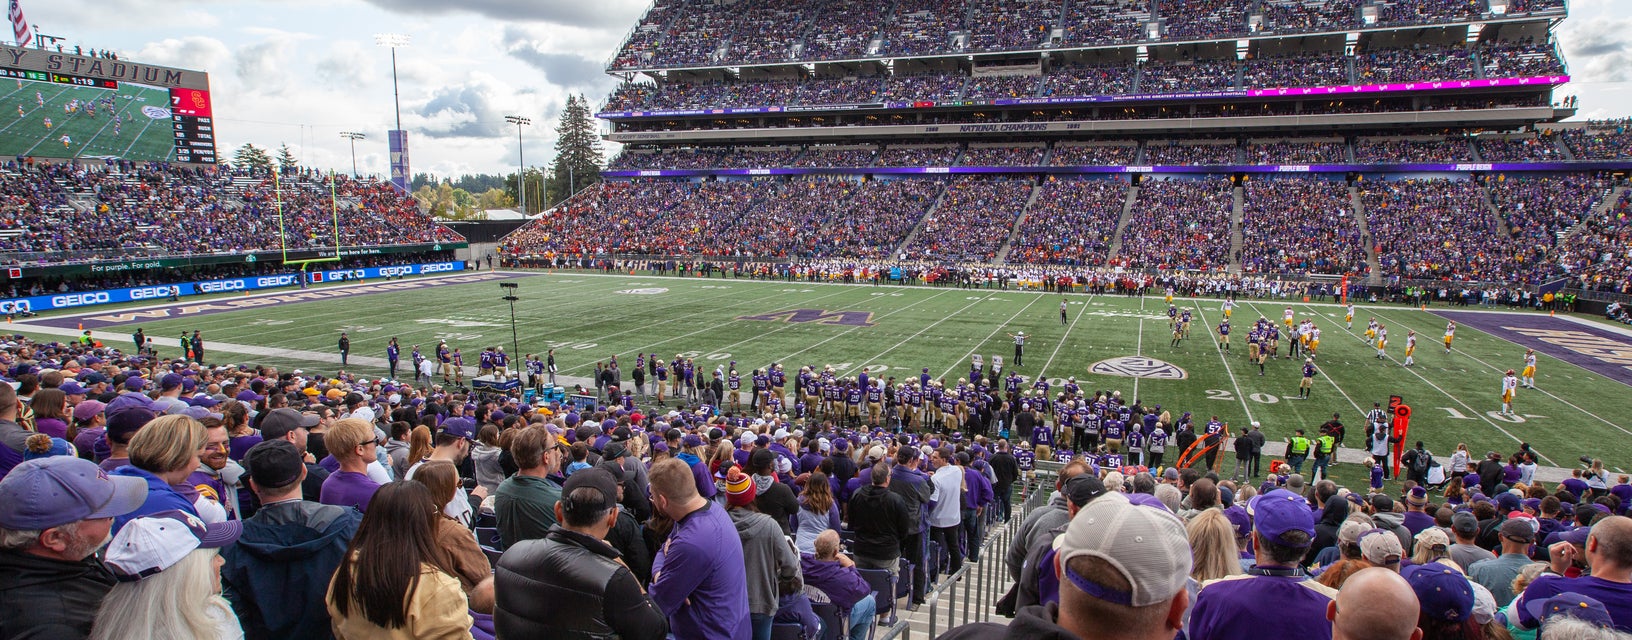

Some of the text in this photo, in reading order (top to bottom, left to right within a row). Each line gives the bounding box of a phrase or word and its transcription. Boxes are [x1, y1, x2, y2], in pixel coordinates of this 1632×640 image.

[48, 54, 184, 85] STADIUM
[71, 77, 94, 86] 1:19
[172, 96, 180, 105] 7
[959, 124, 998, 132] NATIONAL
[1000, 123, 1048, 132] CHAMPIONS
[91, 260, 162, 273] For purple. For gold.
[422, 262, 454, 273] GEICO
[202, 279, 245, 293] GEICO
[52, 291, 110, 307] GEICO
[82, 273, 510, 323] WASHINGTON
[1204, 389, 1280, 404] 20
[1389, 396, 1402, 408] 2
[1120, 413, 1131, 421] 28
[1086, 420, 1097, 429] 45
[1178, 422, 1187, 431] 14
[1038, 432, 1048, 442] 41
[1131, 437, 1138, 446] 7
[1151, 436, 1164, 446] 54
[1019, 457, 1031, 467] 52
[1059, 454, 1071, 463] 56
[1108, 457, 1121, 467] 94
